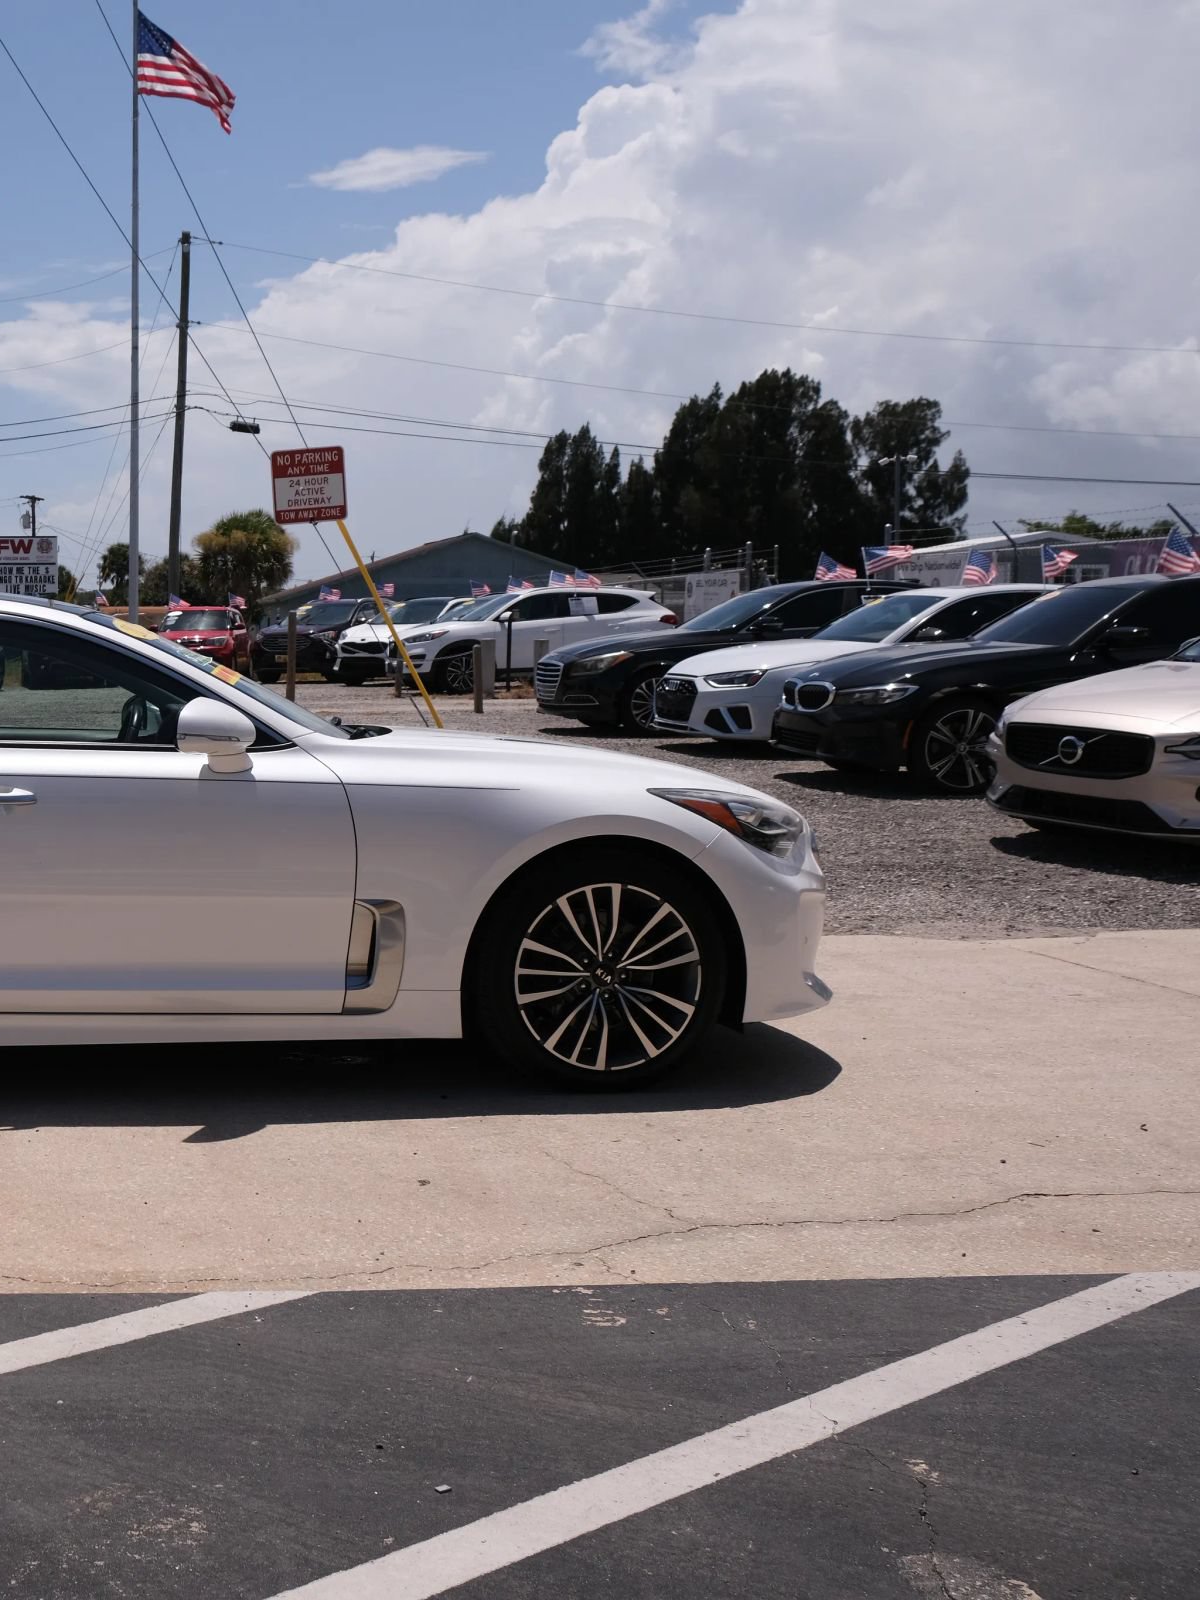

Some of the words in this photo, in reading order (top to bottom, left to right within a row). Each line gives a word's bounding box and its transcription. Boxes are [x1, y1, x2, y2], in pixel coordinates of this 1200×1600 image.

[277, 455, 291, 466] NO
[295, 451, 339, 465] PARKING
[288, 466, 306, 475] ANY
[310, 464, 330, 473] TIME
[289, 479, 301, 488] 24
[305, 477, 329, 486] HOUR
[295, 487, 326, 497] ACTIVE
[288, 496, 332, 508] DRIVEWAY
[280, 511, 296, 520] TOW
[298, 510, 318, 519] AWAY
[321, 508, 342, 517] ZONE
[16, 567, 25, 575] ME
[28, 567, 40, 575] THE
[25, 576, 55, 584] KARAOKE
[25, 584, 47, 593] MUSIC
[595, 968, 612, 984] KIA
